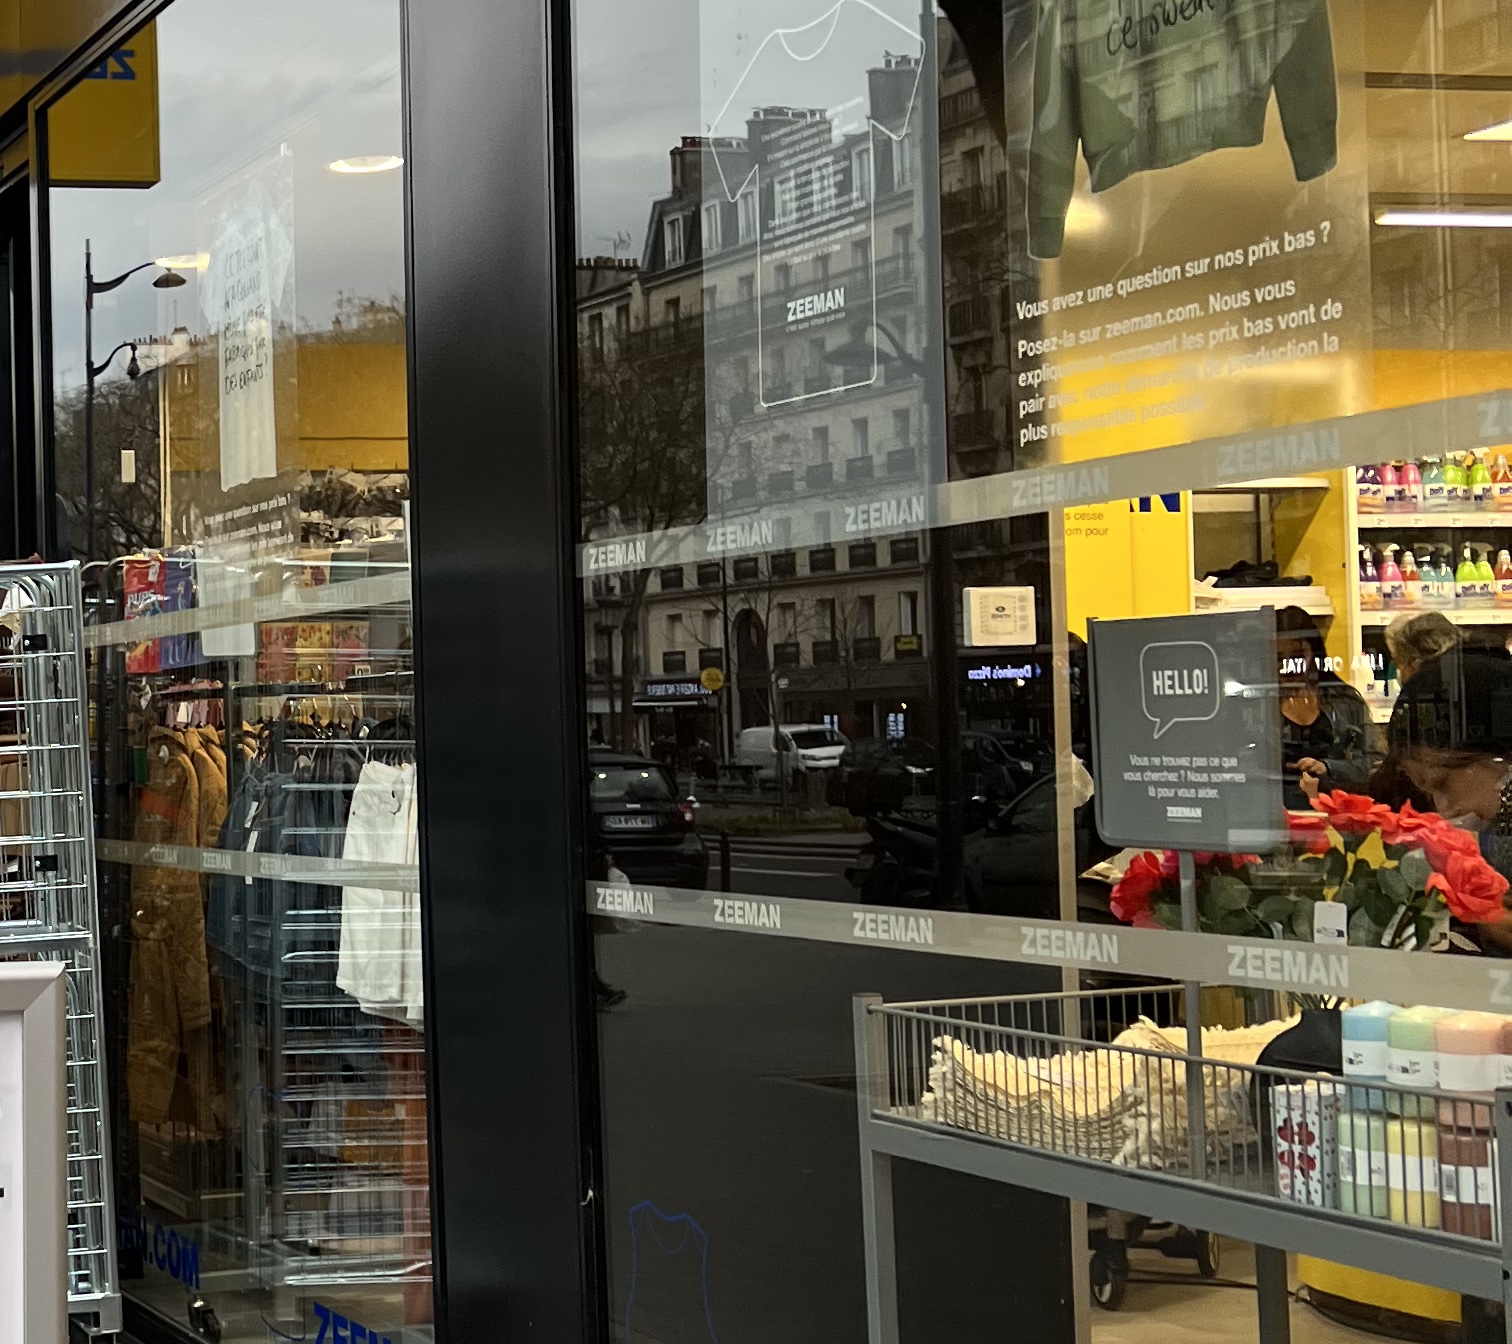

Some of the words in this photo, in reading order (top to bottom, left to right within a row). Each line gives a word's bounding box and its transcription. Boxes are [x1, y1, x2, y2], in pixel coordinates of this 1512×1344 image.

[1106, 13, 1138, 56] ce
[1016, 299, 1049, 320] Vous
[1052, 291, 1084, 311] avez
[1087, 282, 1114, 303] une
[1117, 264, 1181, 298] question
[1185, 257, 1210, 279] sur
[1214, 248, 1244, 271] nos
[1248, 235, 1280, 267] prix
[1284, 228, 1316, 254] bas
[1319, 220, 1332, 244] ?
[787, 286, 845, 323] ZEEMAN
[1017, 328, 1076, 358] Posez-la
[1078, 323, 1101, 344] sur
[1105, 303, 1205, 340] zeeman.com.
[1208, 287, 1251, 315] Nous
[1255, 278, 1296, 303] vous
[1182, 330, 1204, 351] les
[1208, 321, 1239, 350] prix
[1243, 314, 1274, 338] bas
[1278, 305, 1317, 331] vont
[1320, 298, 1343, 321] de
[1019, 393, 1045, 419] pair
[1322, 331, 1339, 356] la
[1019, 420, 1048, 447] plus
[589, 540, 646, 570] ZEEMAN
[706, 519, 773, 552] ZEEMAN
[844, 495, 924, 533] ZEEMAN
[1011, 467, 1110, 508] ZEEMAN
[1217, 428, 1341, 477] ZEEMAN
[1073, 512, 1104, 521] cesse
[1085, 528, 1109, 538] pour
[1152, 668, 1209, 695] HELLO!
[1129, 754, 1149, 766] Vous
[1150, 757, 1161, 766] ne
[1162, 755, 1191, 766] trouvez
[1192, 757, 1208, 768] pas
[1209, 757, 1220, 766] ce
[1221, 757, 1238, 768] que
[1123, 772, 1142, 781] vous
[1143, 770, 1179, 781] cherchez
[1187, 770, 1209, 782] Nous
[1210, 773, 1246, 783] sommes
[1157, 788, 1175, 799] pour
[1177, 788, 1196, 797] vous
[1166, 806, 1202, 817] ZEEMAN
[202, 852, 232, 870] ZEEMAN
[596, 887, 654, 915] ZEEMAN
[713, 898, 781, 928] ZEEMAN
[852, 911, 934, 945] ZEEMAN
[1020, 926, 1119, 964] ZEEMAN
[1227, 944, 1349, 989] ZEEMAN
